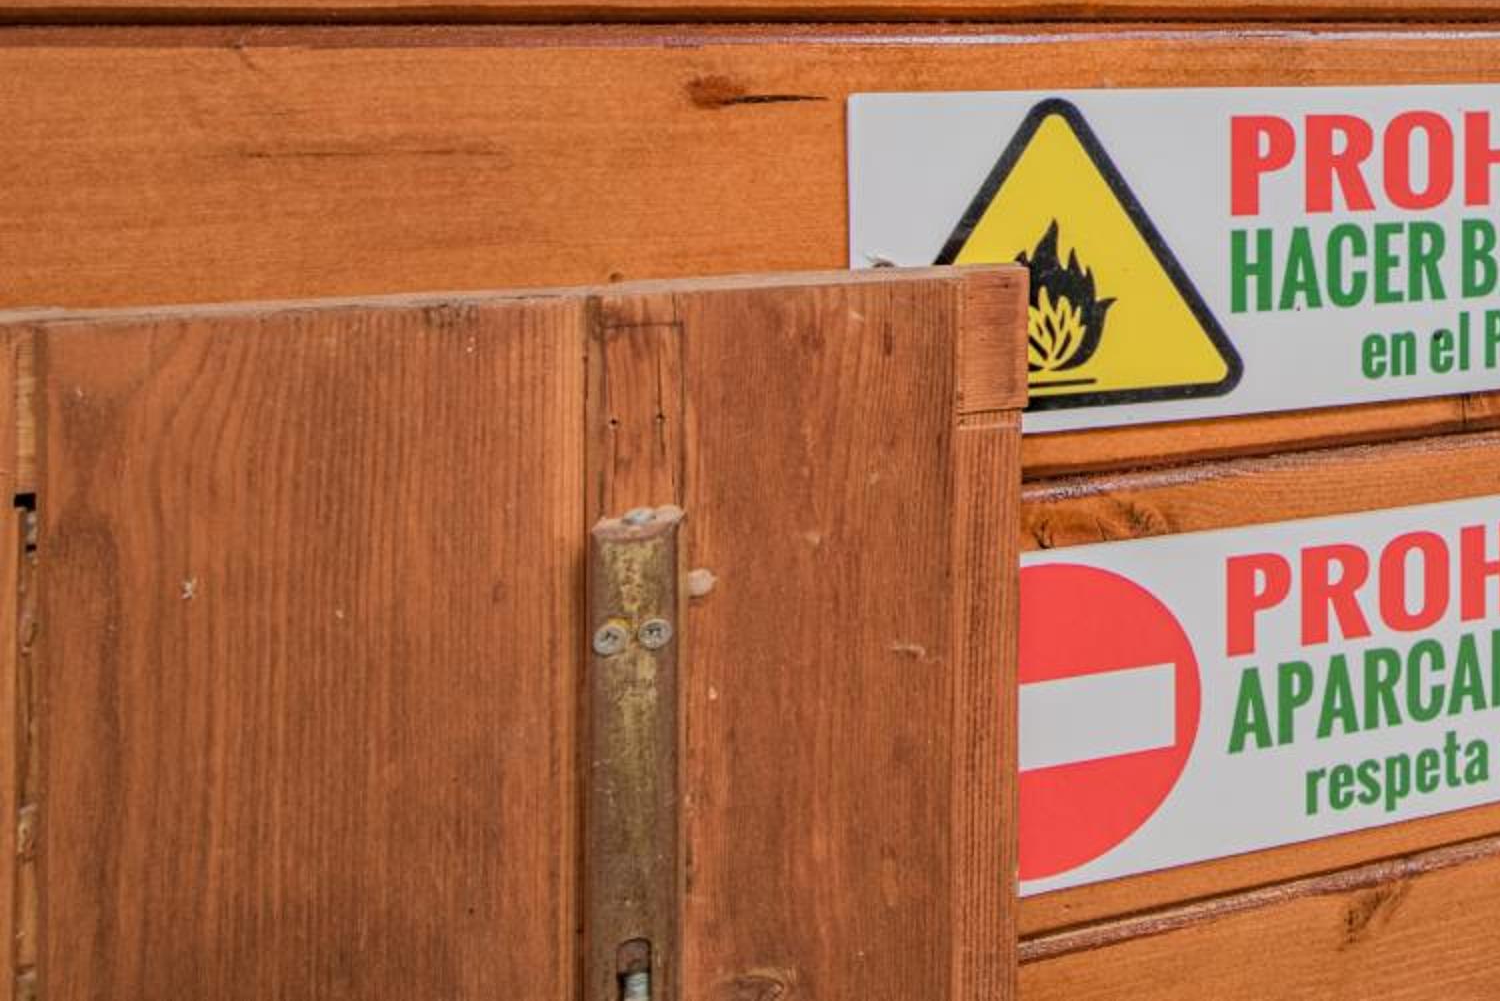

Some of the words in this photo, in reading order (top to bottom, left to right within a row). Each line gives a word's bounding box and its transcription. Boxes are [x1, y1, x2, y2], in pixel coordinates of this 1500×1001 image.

[1230, 222, 1447, 314] HACER
[1362, 329, 1417, 380] en
[1429, 311, 1470, 374] el
[1306, 732, 1489, 816] respeta
